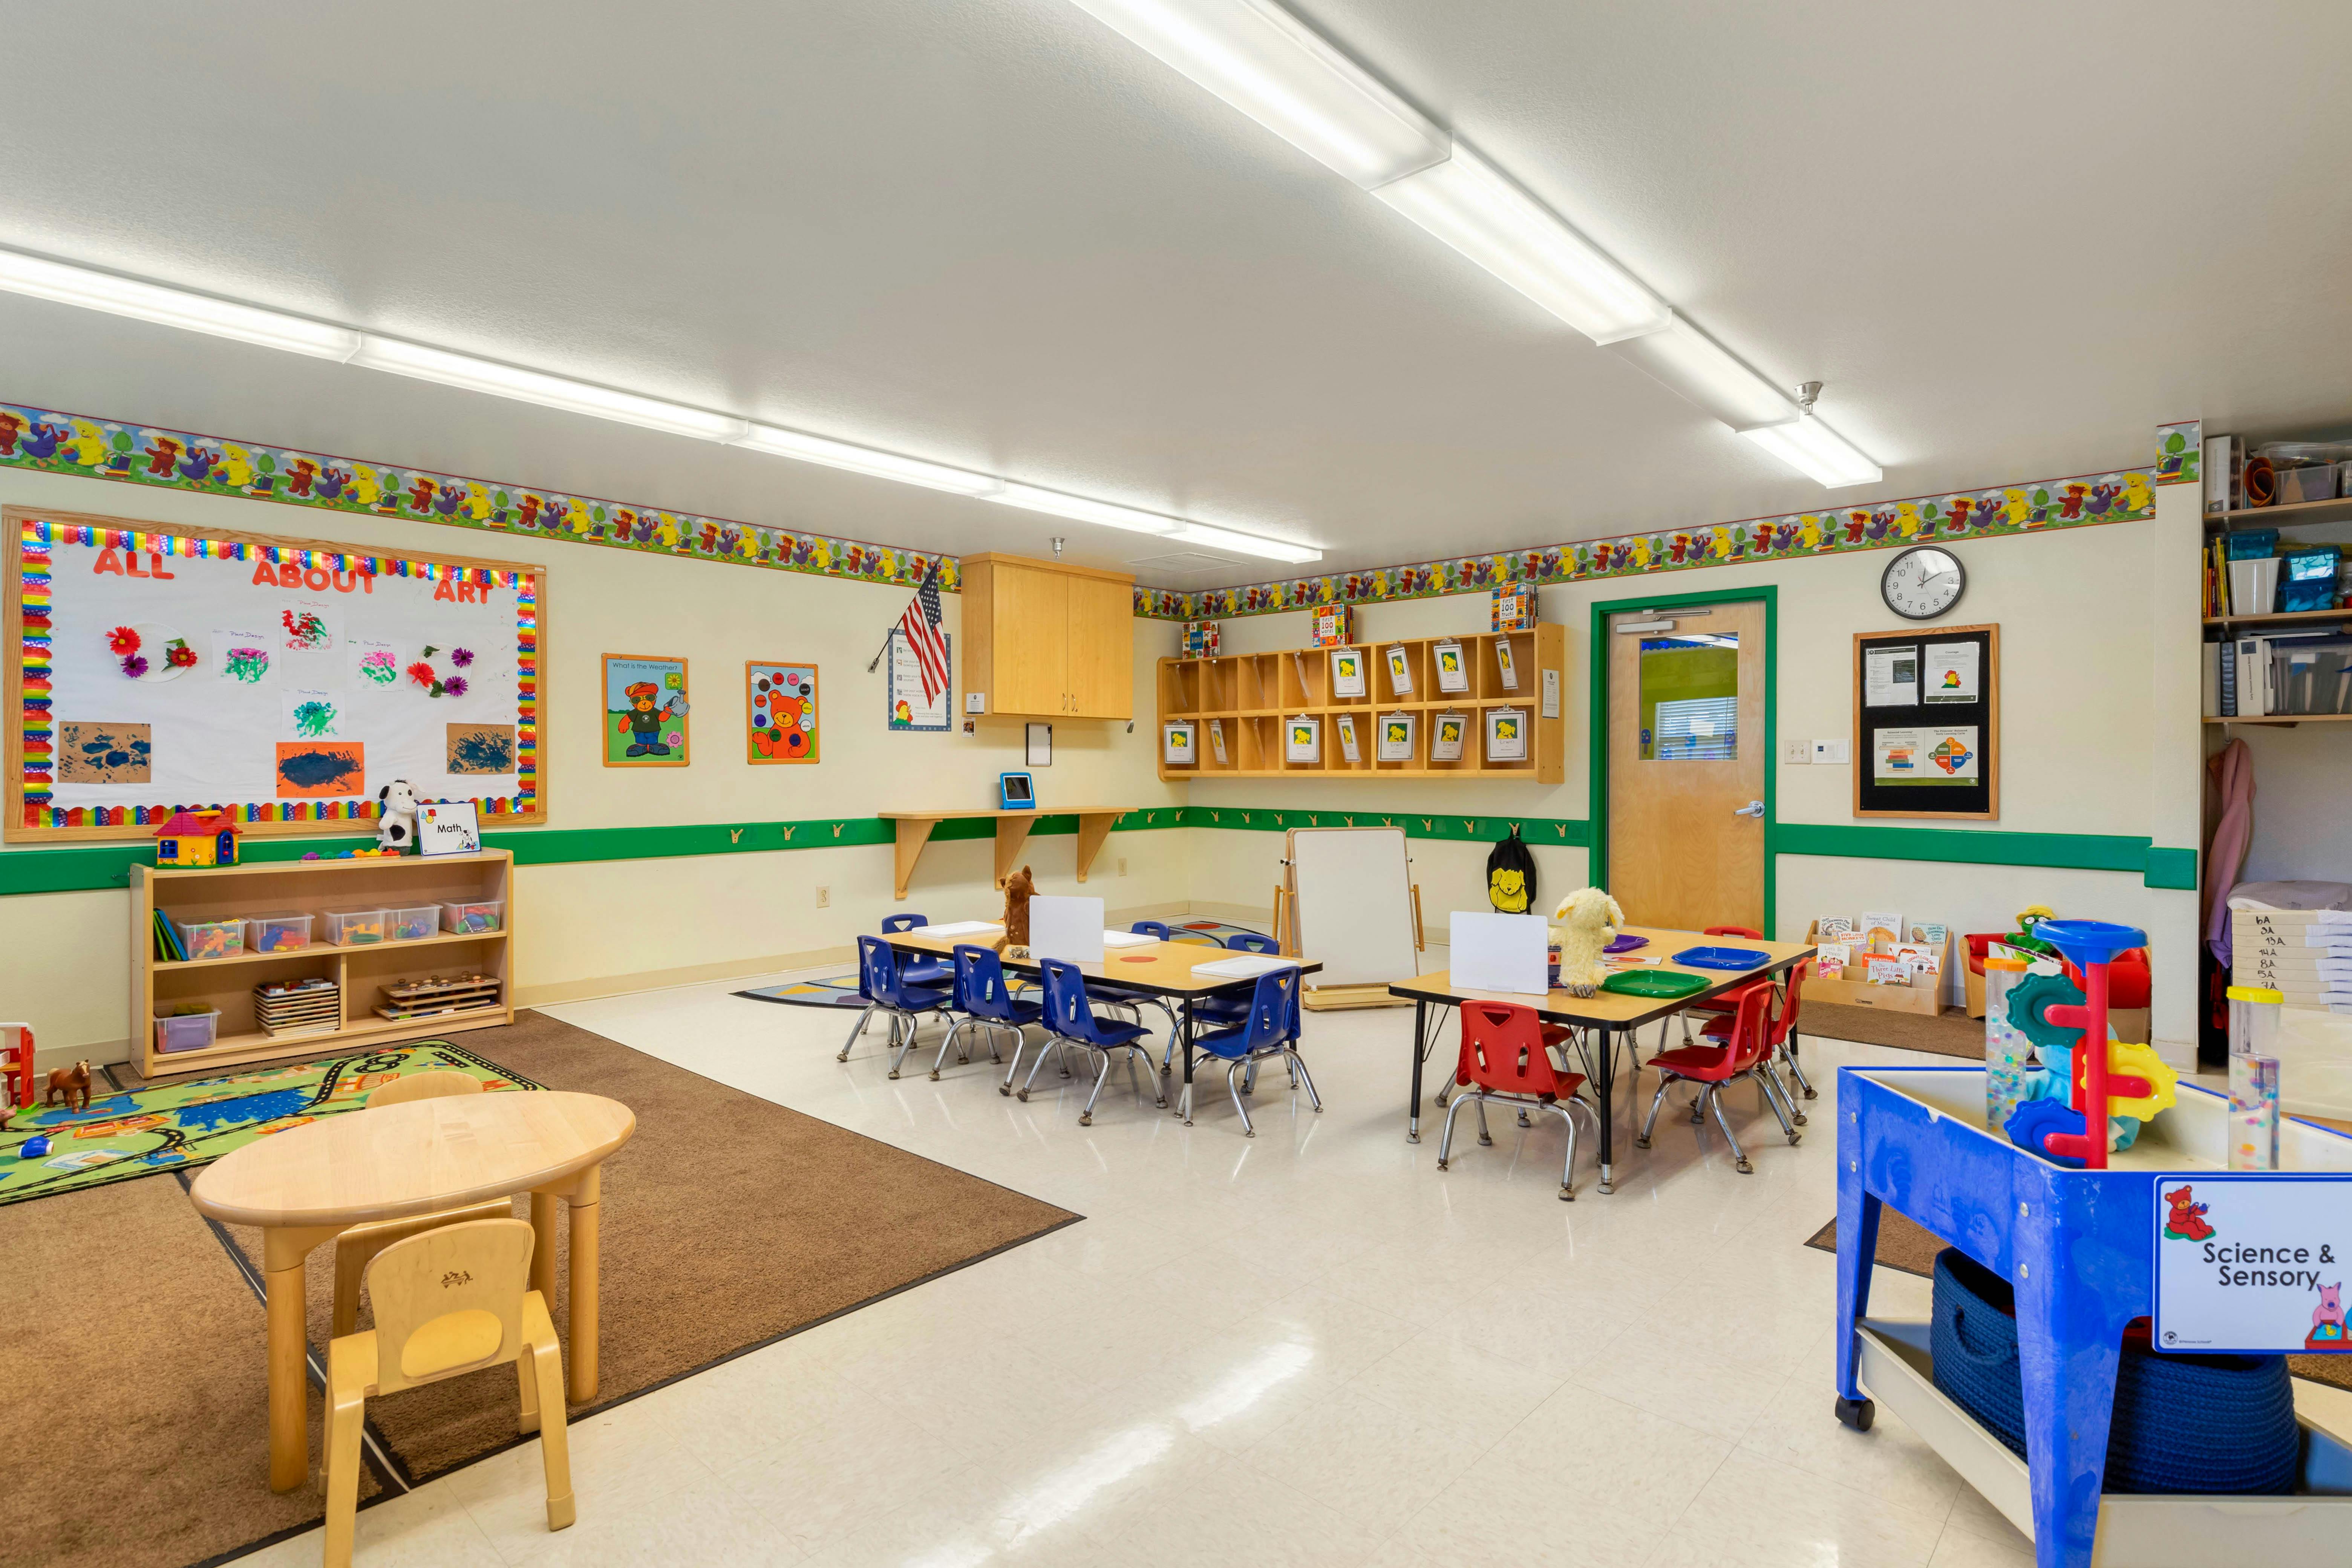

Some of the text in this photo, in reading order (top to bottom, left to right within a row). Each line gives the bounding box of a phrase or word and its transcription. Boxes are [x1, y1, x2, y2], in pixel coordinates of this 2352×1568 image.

[93, 549, 493, 604] ALL ABOUT ART
[438, 824, 462, 833] Math
[2261, 926, 2275, 935] 3A
[2260, 959, 2279, 969] 8A
[1890, 965, 1905, 973] Little
[2258, 970, 2276, 979] 5A
[2262, 982, 2278, 990] 7A
[2203, 1242, 2336, 1264] Science &
[2219, 1265, 2321, 1291] Sensory
